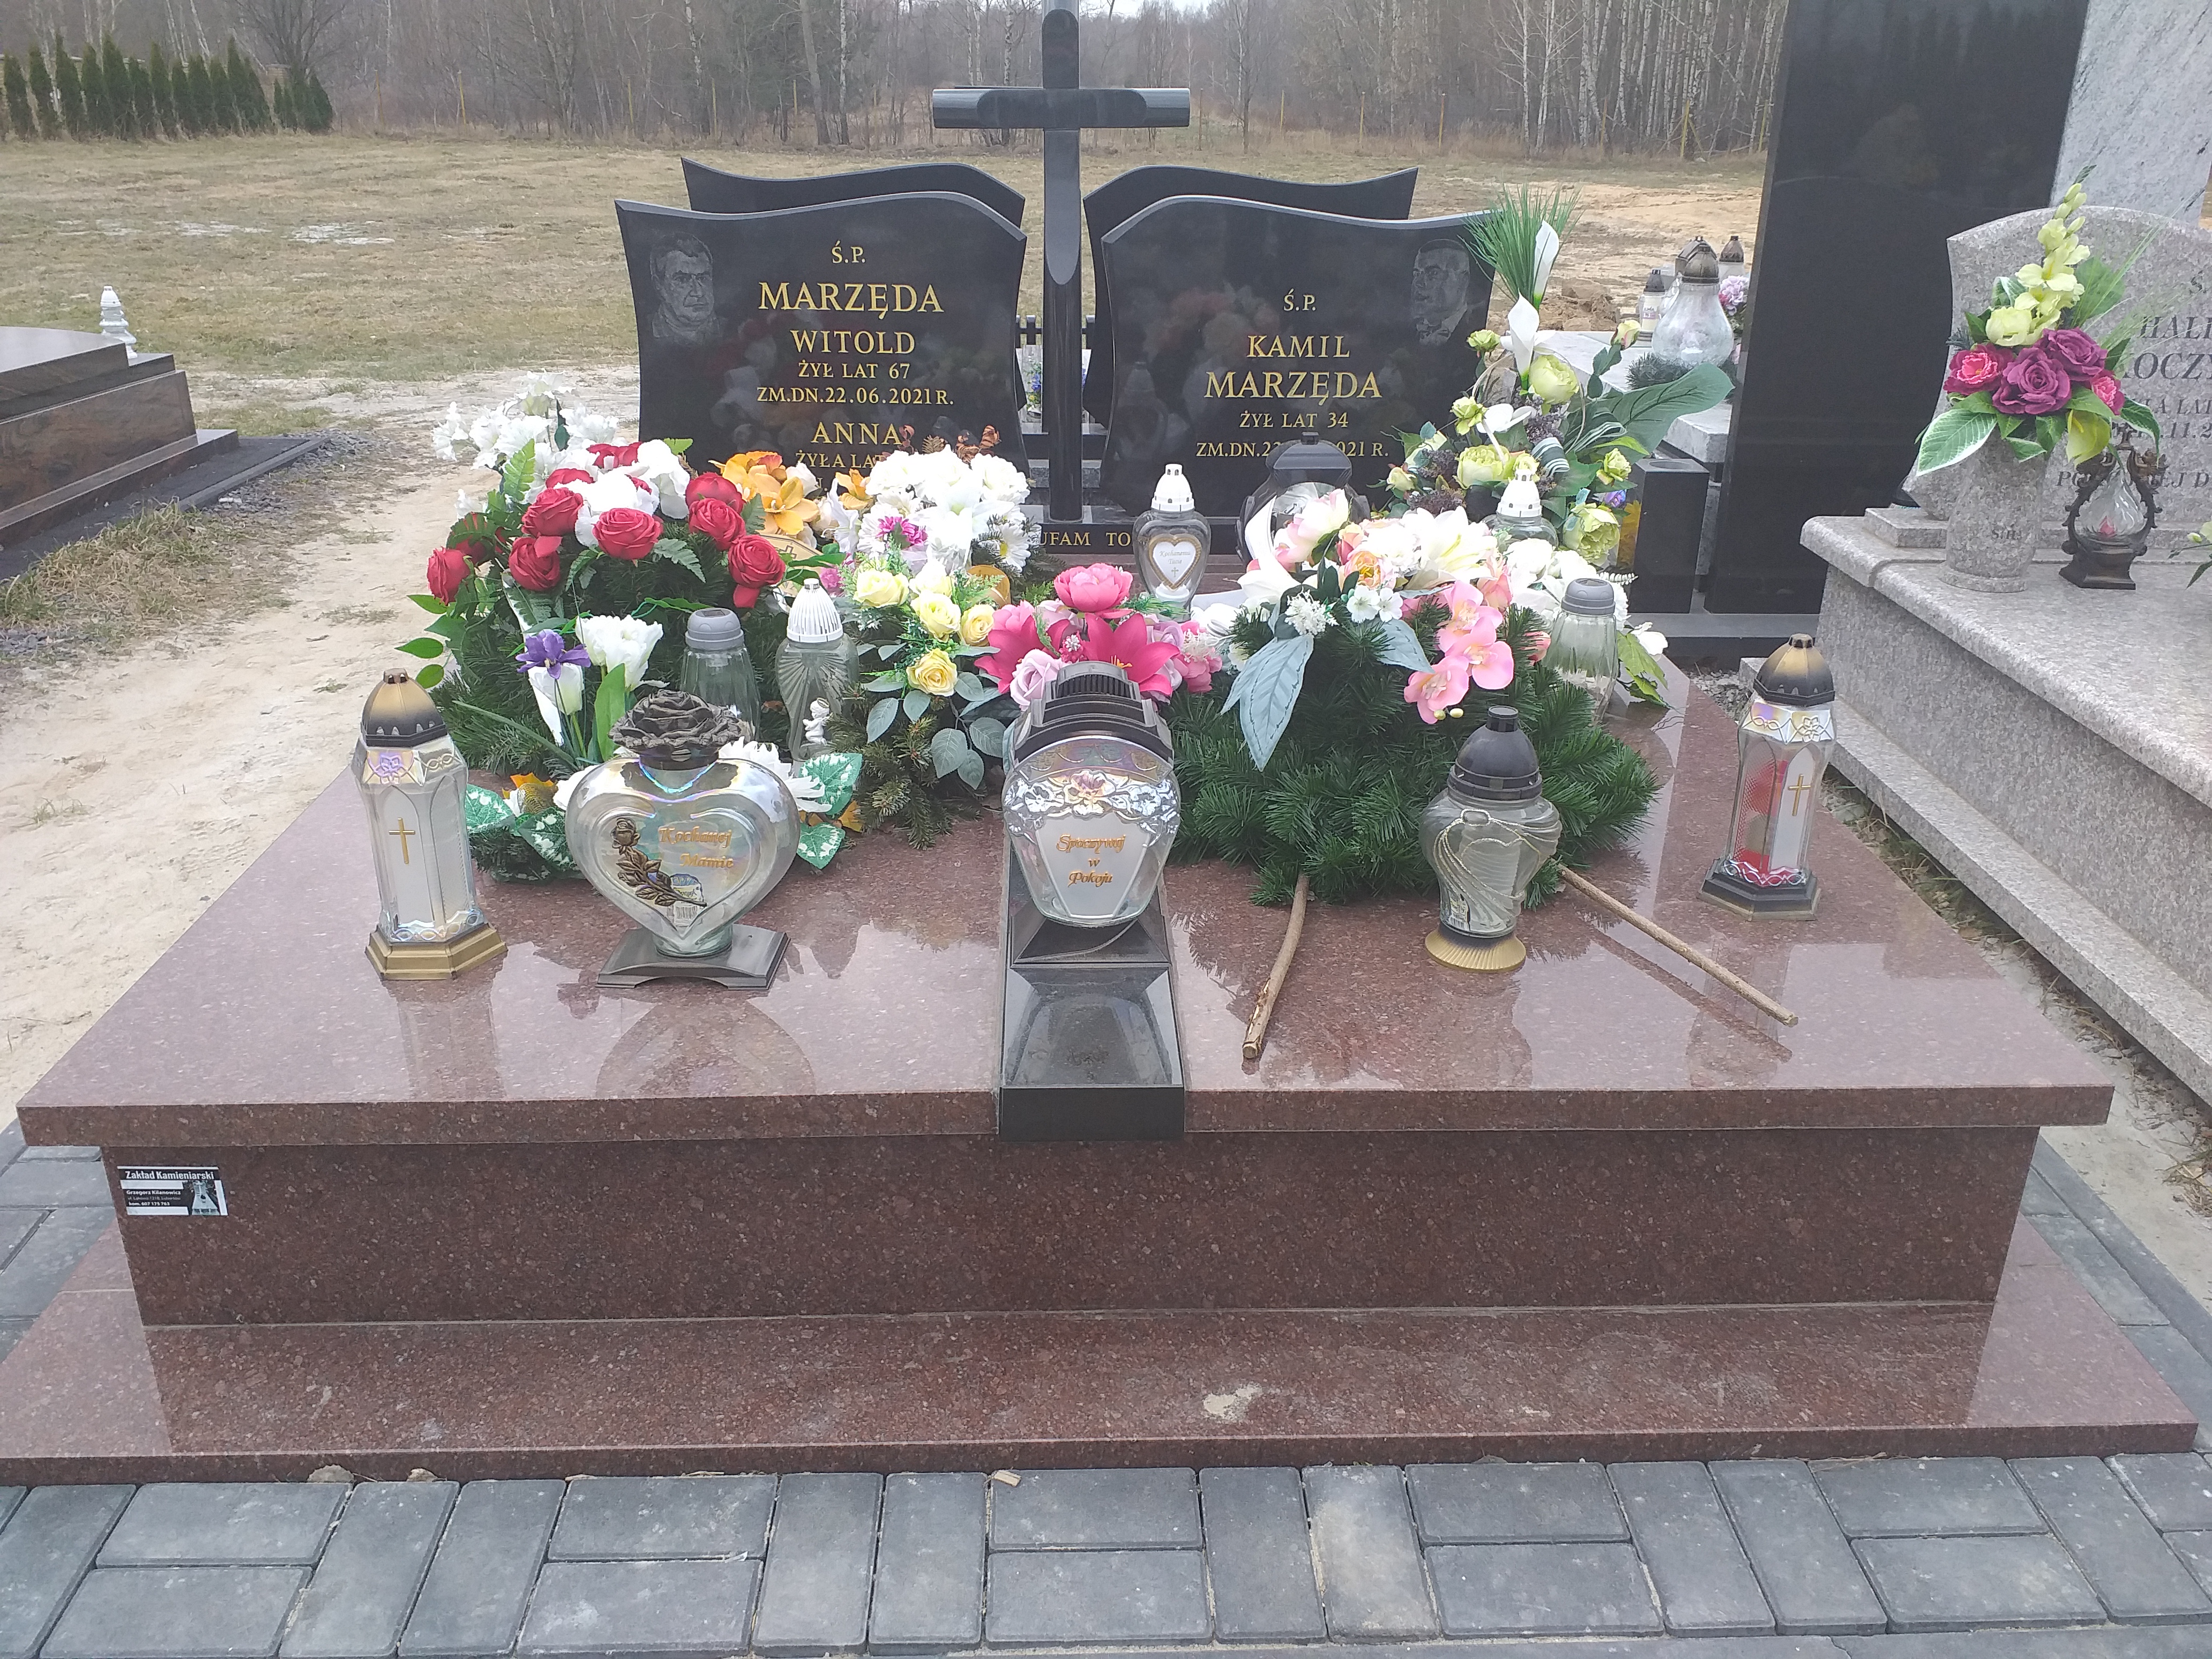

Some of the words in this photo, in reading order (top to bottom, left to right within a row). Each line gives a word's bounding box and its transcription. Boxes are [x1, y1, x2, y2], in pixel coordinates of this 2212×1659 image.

[832, 240, 866, 264] Ś.P.
[758, 282, 944, 319] MARZĘDA
[1284, 288, 1316, 311] Ś.P.
[790, 330, 915, 354] WITOLD
[1247, 335, 1350, 357] KAMIL
[798, 360, 833, 377] ŻYŁ
[842, 363, 878, 378] LAT
[889, 363, 910, 379] 67
[1204, 371, 1382, 406] MARZĘDA
[1239, 410, 1274, 428] ŻYŁ
[1282, 413, 1318, 428] LAT
[1328, 412, 1348, 428] 34
[811, 422, 902, 445] ANNA
[1371, 442, 1389, 457] R.
[659, 826, 732, 848] Kochanej
[679, 853, 734, 868] Mamie
[1088, 858, 1100, 867] w
[1067, 870, 1113, 887] Pokoju
[125, 1171, 155, 1179] Zakład
[156, 1171, 214, 1179] Kamieniarski
